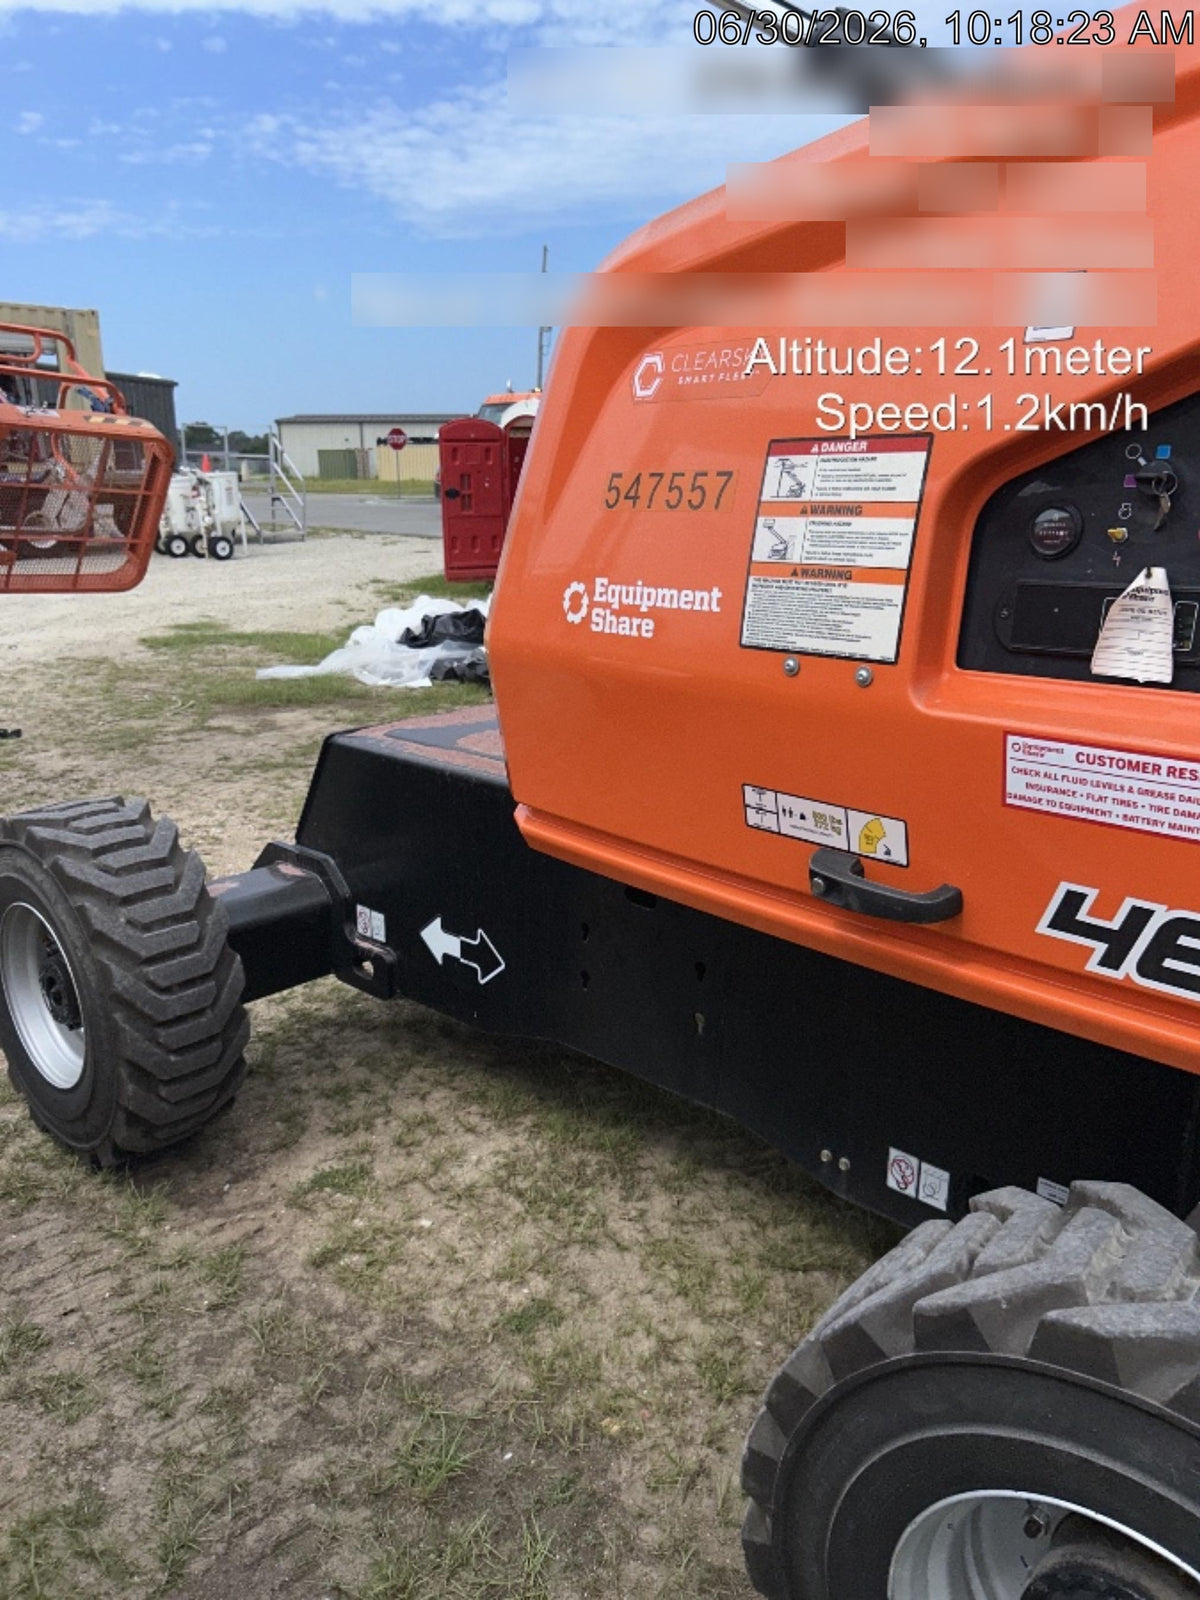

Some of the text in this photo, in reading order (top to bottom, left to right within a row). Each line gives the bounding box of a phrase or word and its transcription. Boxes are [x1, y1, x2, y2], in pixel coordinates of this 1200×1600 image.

[678, 374, 715, 385] SMART
[820, 441, 868, 453] DANGER
[605, 470, 734, 511] 547557
[809, 504, 863, 516] WARNING
[800, 567, 853, 580] WARNING
[593, 577, 723, 613] Equipment
[590, 607, 655, 638] Share
[1075, 751, 1200, 782] CUSTOMER RES
[1011, 766, 1041, 778] CHECK
[1043, 771, 1060, 781] ALL
[1061, 774, 1088, 786] FLUID
[1090, 779, 1125, 793] LEVELS
[1137, 787, 1176, 801] GREASE
[1025, 781, 1078, 798] INSURANCE
[1086, 792, 1109, 803] FLAT
[1112, 797, 1138, 810] TIRES
[1148, 803, 1171, 815] TIRE
[1007, 792, 1043, 806] DAMAGE
[1046, 798, 1057, 808] TO
[1059, 801, 1112, 819] EQUIPMENT
[1122, 813, 1165, 828] BATTERY
